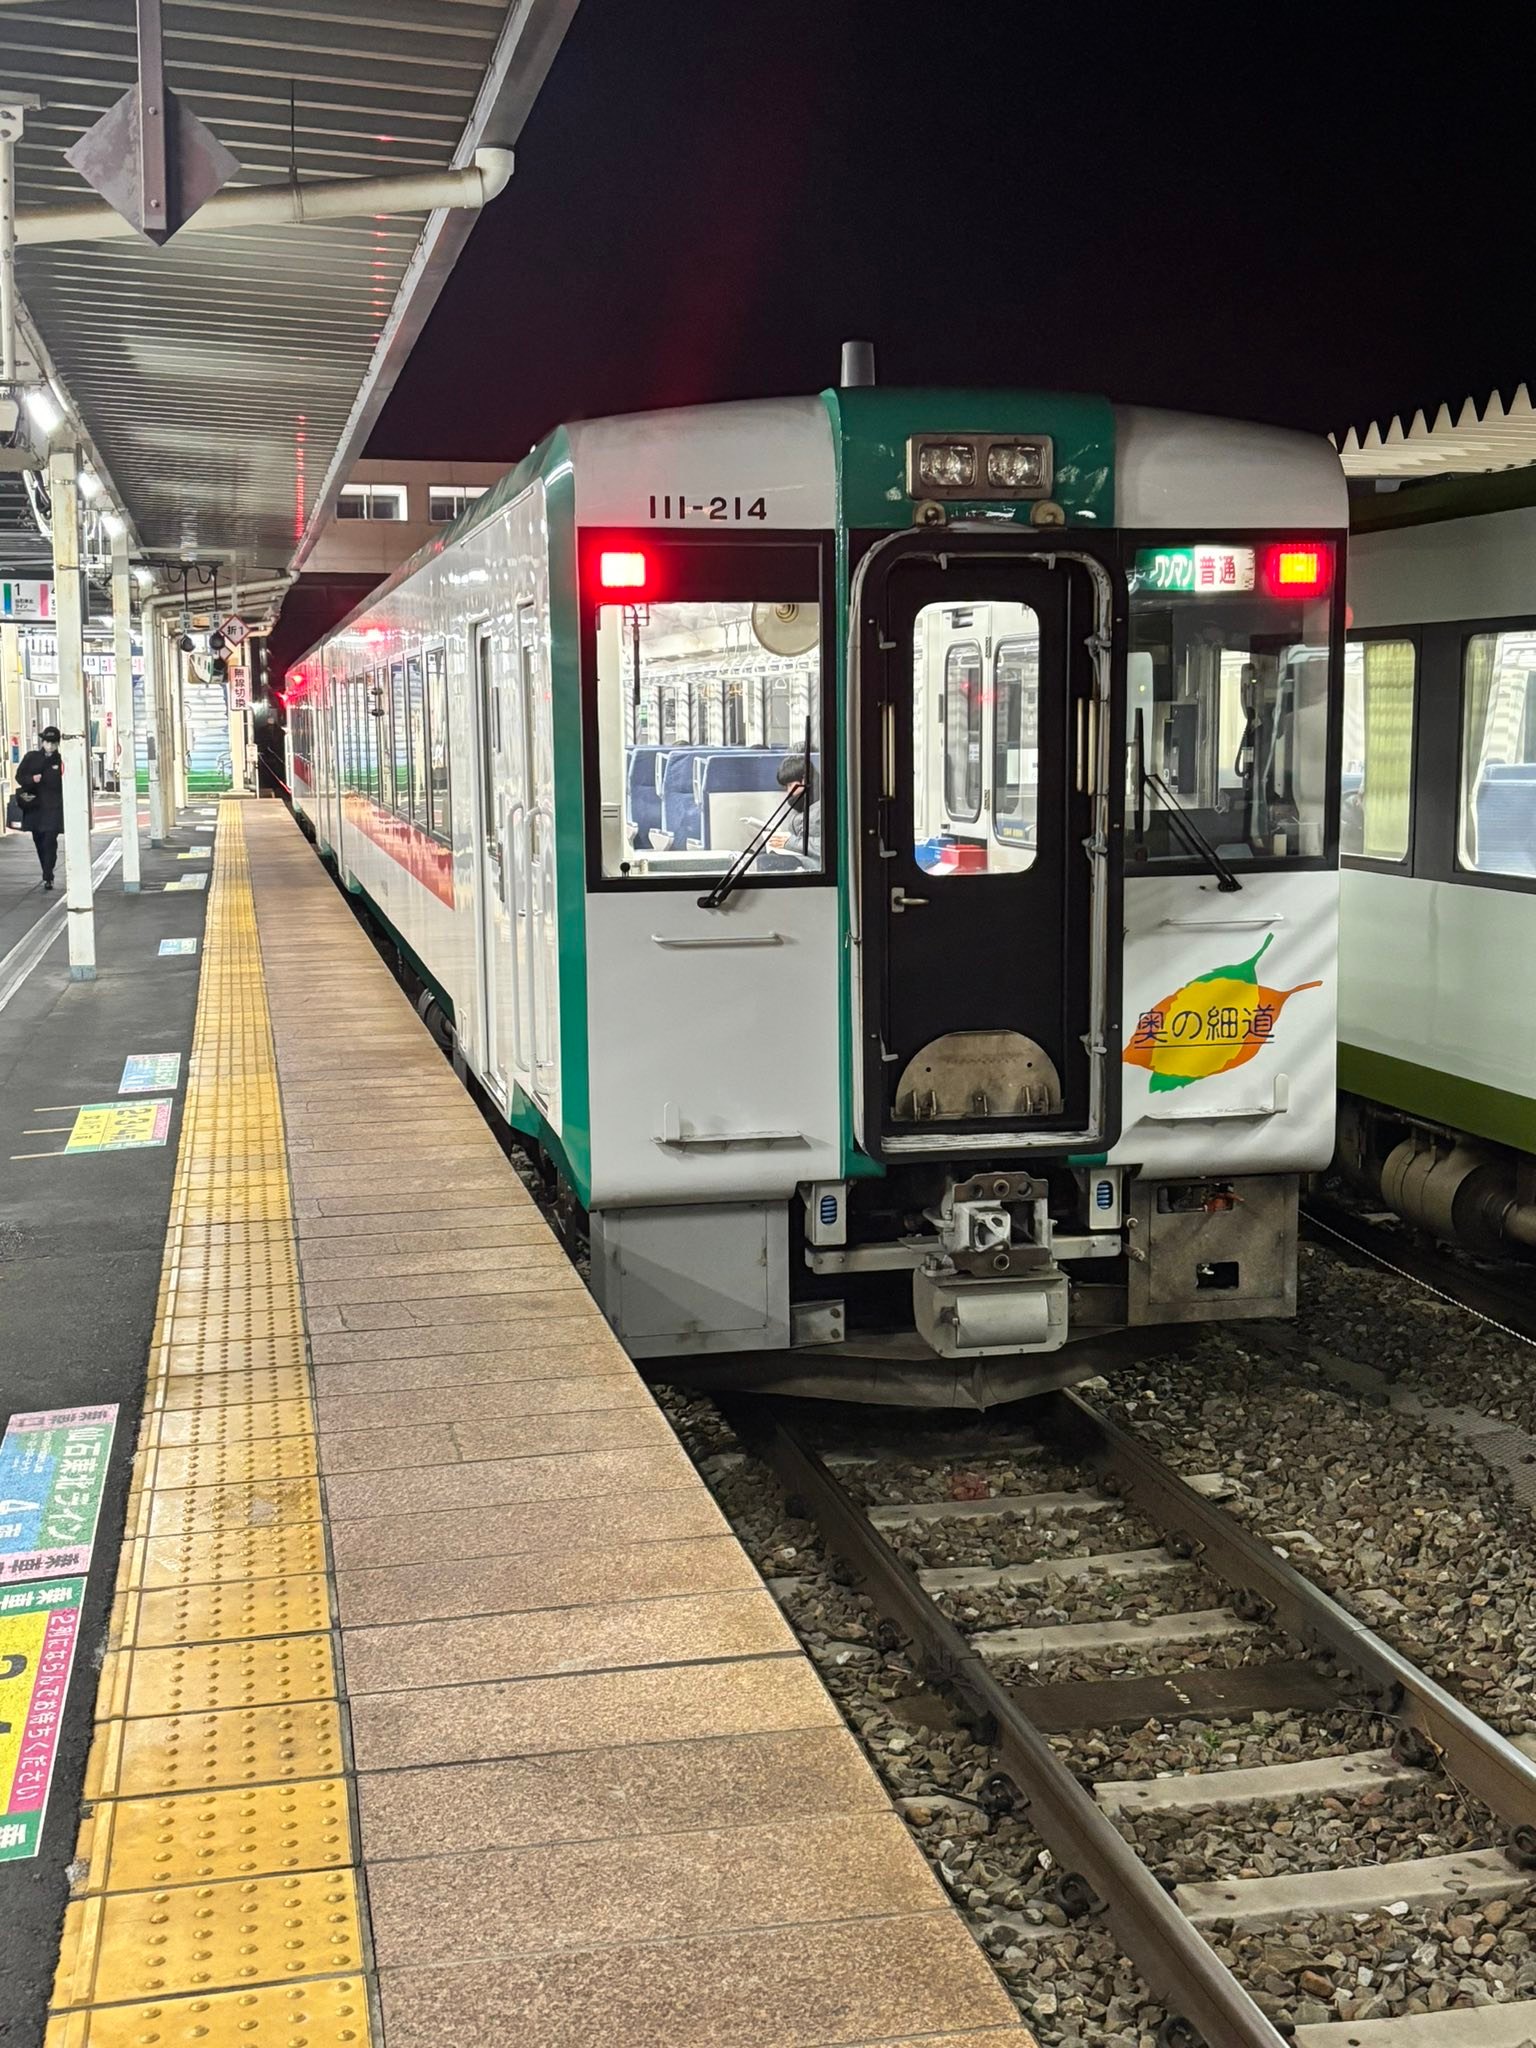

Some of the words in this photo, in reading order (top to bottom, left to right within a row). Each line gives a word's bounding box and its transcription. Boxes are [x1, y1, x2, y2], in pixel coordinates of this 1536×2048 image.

[649, 495, 767, 520] 111-214
[1200, 555, 1236, 585] 普通
[14, 583, 20, 596] 1
[234, 668, 246, 708] 無線切換
[1134, 1003, 1275, 1044] 奥の細道
[48, 1426, 106, 1541] 仙石東北ライン
[0, 1553, 80, 1575] 乗車
[17, 1614, 76, 1802] 2列にならんでお待ちください
